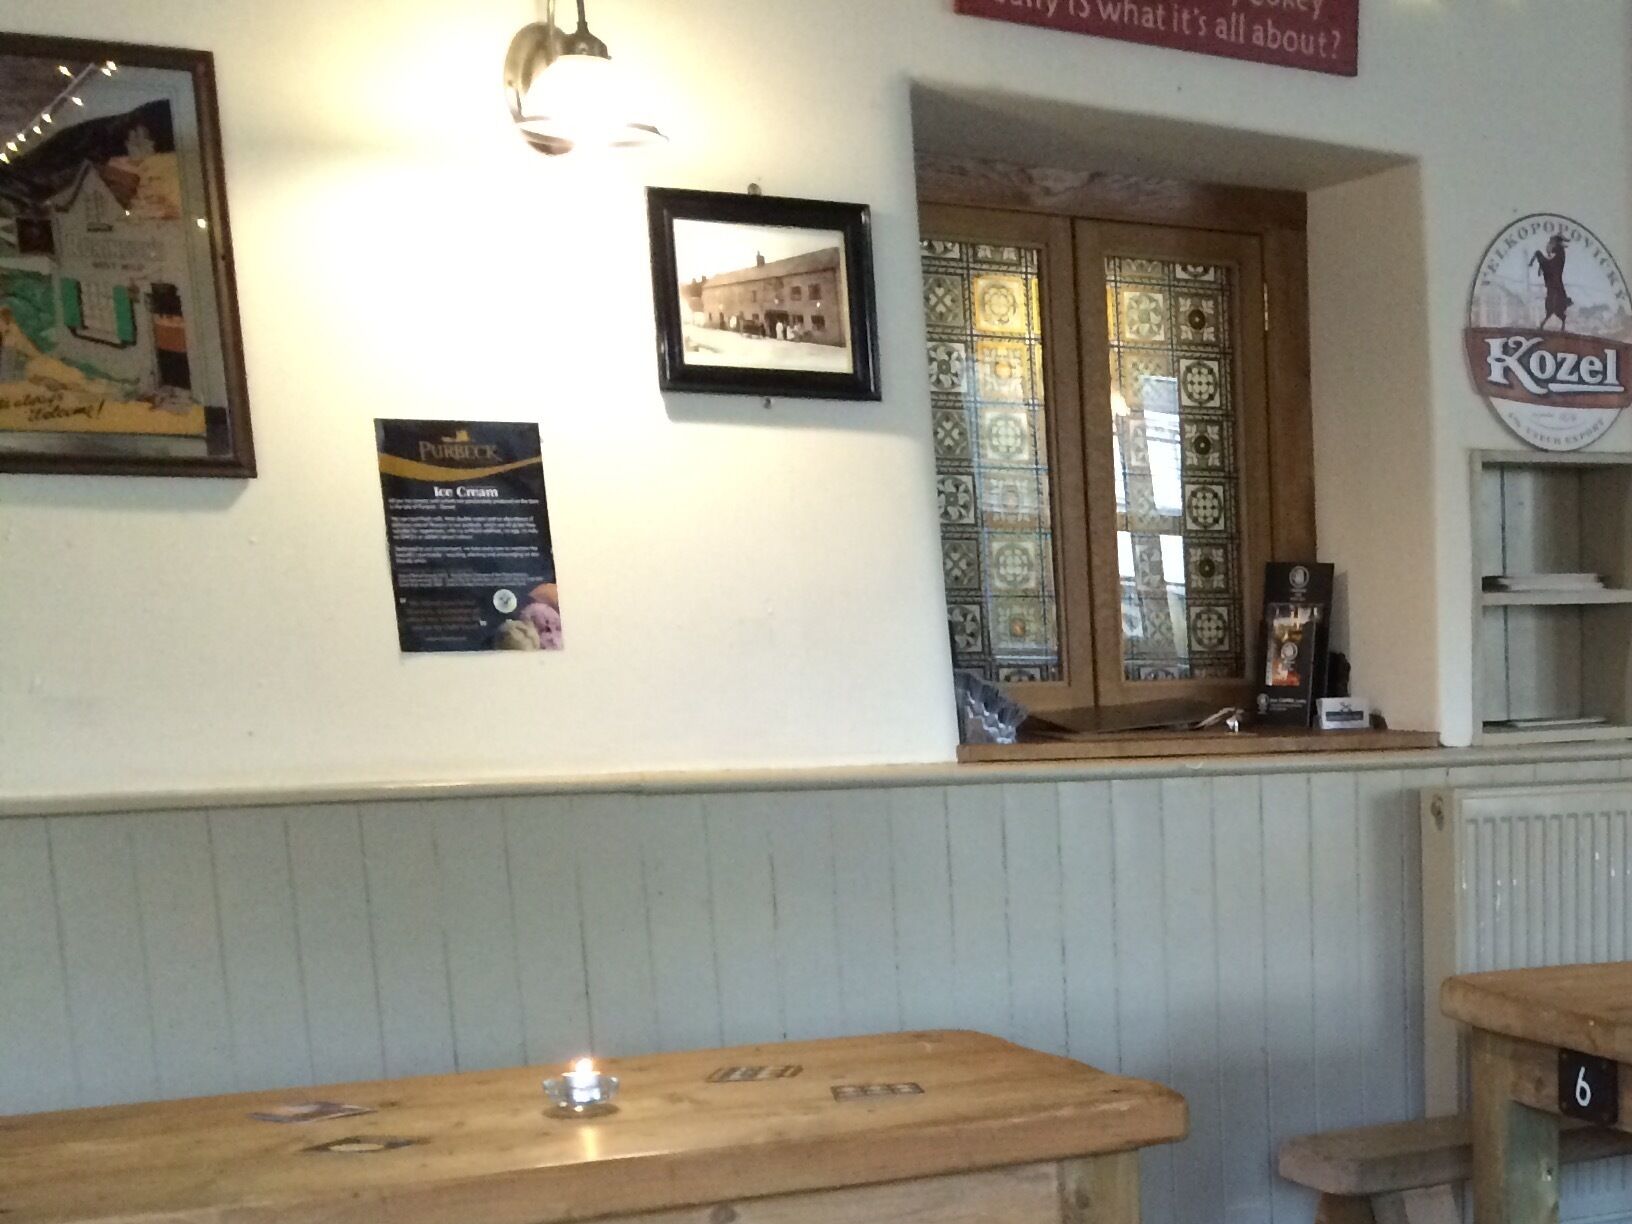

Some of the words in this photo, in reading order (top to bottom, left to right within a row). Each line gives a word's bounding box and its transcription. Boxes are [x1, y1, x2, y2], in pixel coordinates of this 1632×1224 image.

[1098, 0, 1166, 31] what
[1173, 3, 1207, 37] it's
[1215, 11, 1246, 45] all
[1252, 18, 1342, 60] about?
[1484, 335, 1624, 395] Kozel
[433, 486, 454, 498] Ice
[456, 486, 499, 498] Cream
[1574, 1065, 1592, 1108] 6
